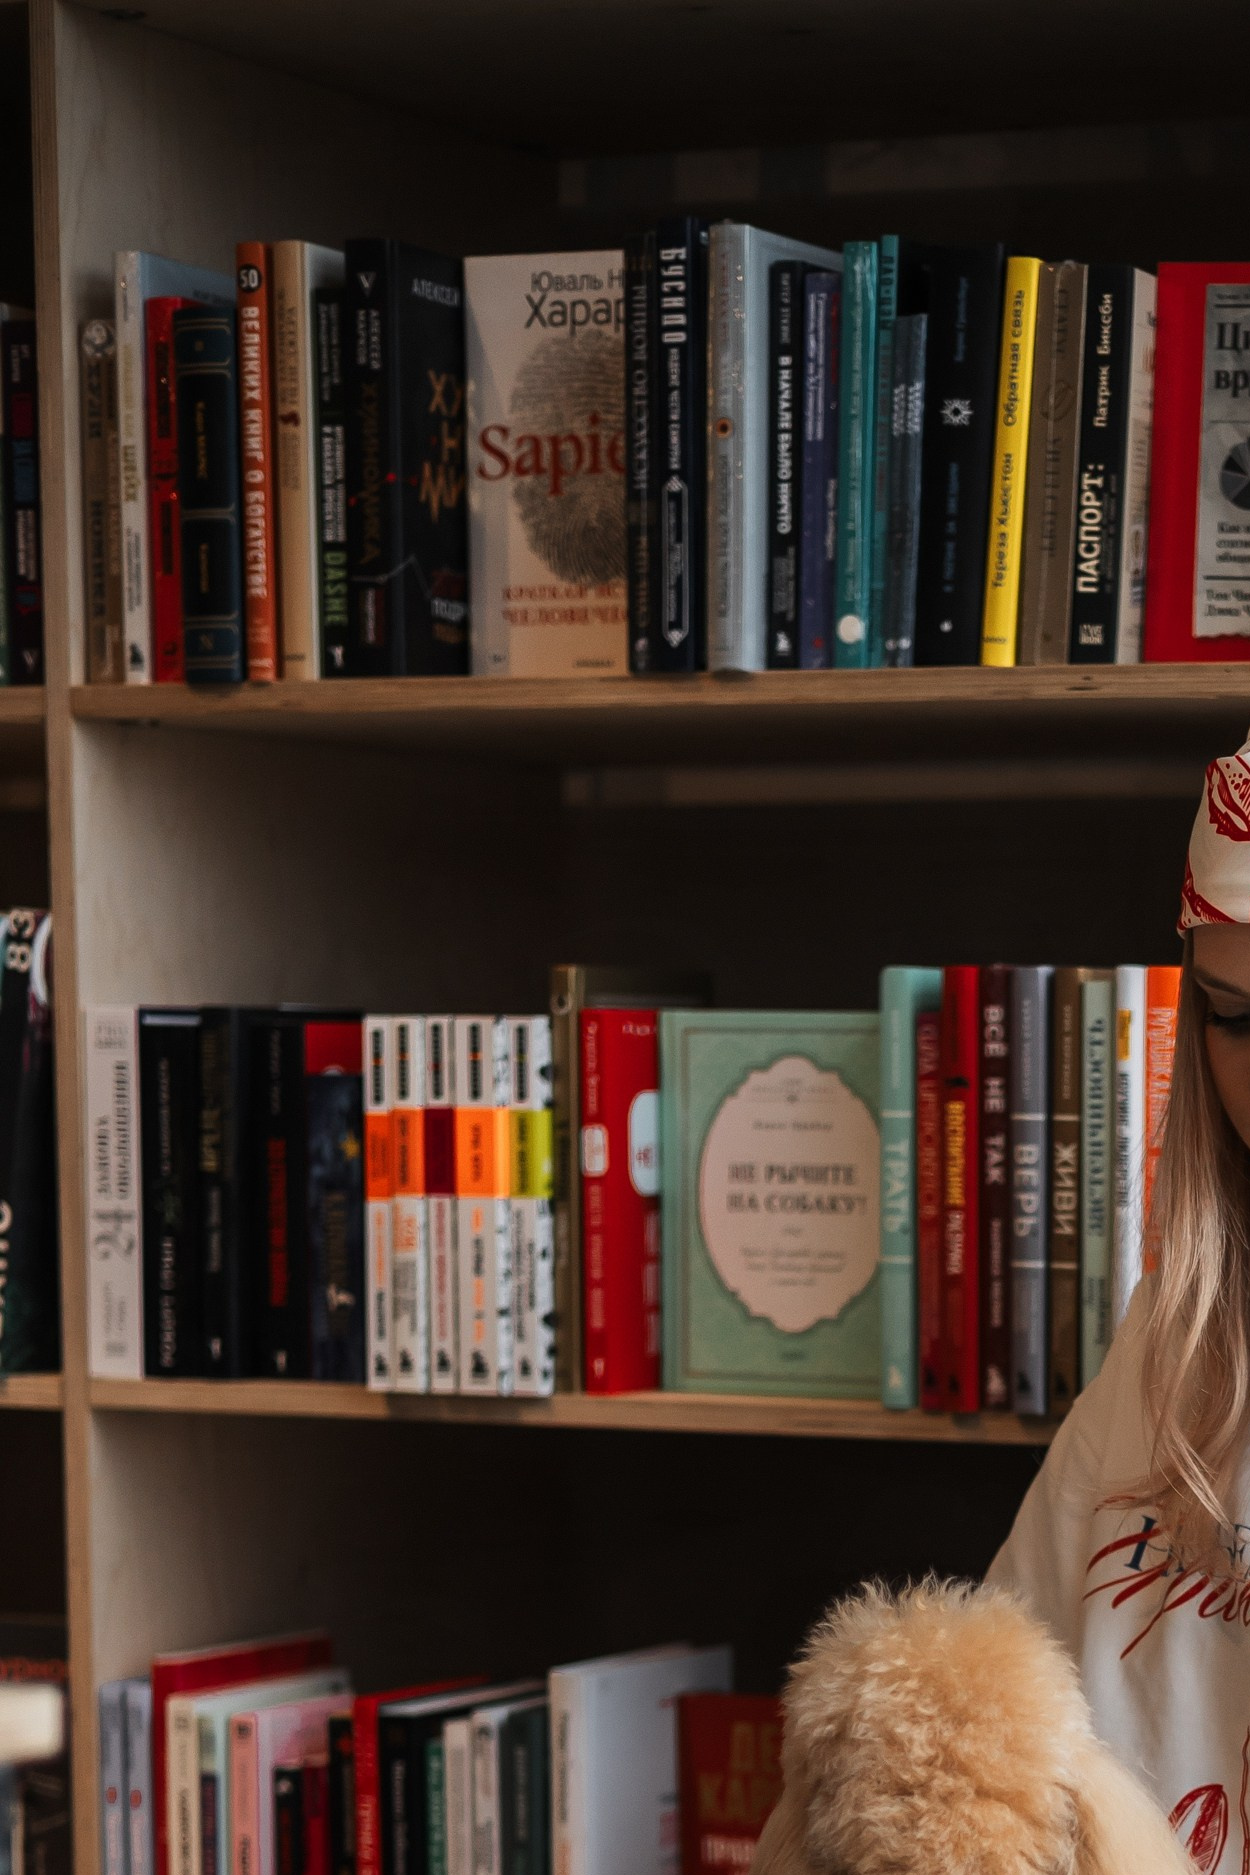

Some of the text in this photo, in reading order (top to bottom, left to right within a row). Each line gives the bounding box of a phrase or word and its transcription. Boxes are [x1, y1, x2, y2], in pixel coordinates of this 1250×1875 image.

[240, 269, 259, 287] 50
[530, 270, 602, 293] Юваль
[660, 247, 687, 343] БУСИДО
[777, 370, 792, 431] НАЧАЛЕ
[1003, 289, 1025, 427] Обратная связь
[1093, 293, 1113, 428] Патрик Биксби
[242, 305, 269, 599] ВЕЛИКИХ КНИГ О БОГАТСТВЕ
[777, 434, 792, 480] БЫЛО
[992, 452, 1015, 588] Тереза Хьюстон
[1076, 464, 1104, 594] ПАСПОРТ:
[324, 550, 348, 625] DASHE
[984, 1004, 1007, 1185] ВСЕ НЕ ТАК
[884, 1138, 910, 1232] ТРАТЬ
[1013, 1142, 1039, 1237] ВЕРЬ
[1053, 1142, 1078, 1236] ЖИВИ
